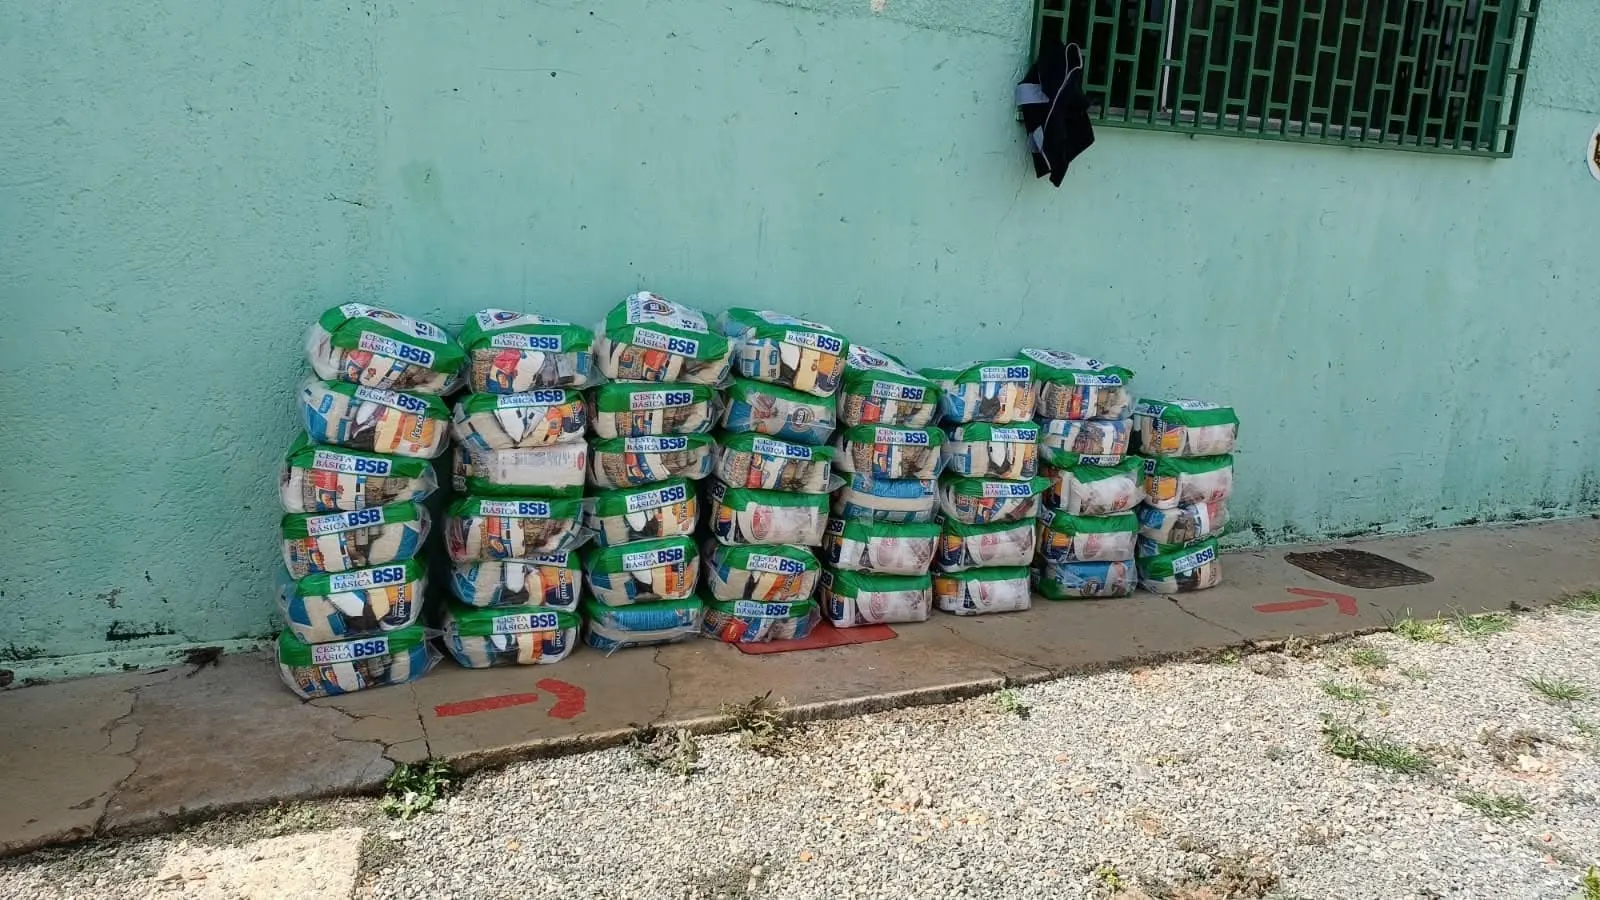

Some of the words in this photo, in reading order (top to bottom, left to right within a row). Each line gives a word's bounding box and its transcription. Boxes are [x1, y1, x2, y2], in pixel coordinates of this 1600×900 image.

[414, 321, 428, 336] 15
[530, 337, 559, 349] BSB
[668, 338, 695, 354] BSB
[817, 336, 840, 351] BSB
[400, 344, 432, 364] BSB
[1008, 367, 1028, 378] BSB
[535, 391, 562, 402] BSB
[634, 393, 662, 401] CESTA
[666, 393, 691, 405] BSB
[902, 387, 923, 400] BSB
[397, 395, 427, 411] BSB
[905, 433, 927, 443] BSB
[1018, 430, 1036, 440] BSB
[660, 438, 685, 449] BSB
[318, 452, 351, 462] CESTA
[355, 460, 388, 473] BSB
[660, 486, 684, 502] BSB
[1010, 485, 1030, 495] BSB
[630, 494, 658, 502] CESTA
[519, 503, 547, 515] BSB
[311, 515, 345, 525] CESTA
[348, 510, 380, 526] BSB
[627, 553, 656, 561] CESTA
[658, 549, 683, 563] BSB
[1196, 548, 1213, 563] BSB
[779, 559, 803, 573] BSB
[372, 568, 403, 583] BSB
[766, 605, 789, 615] BSB
[530, 615, 556, 628] BSB
[316, 645, 351, 653] CESTA
[353, 641, 385, 656] BSB
